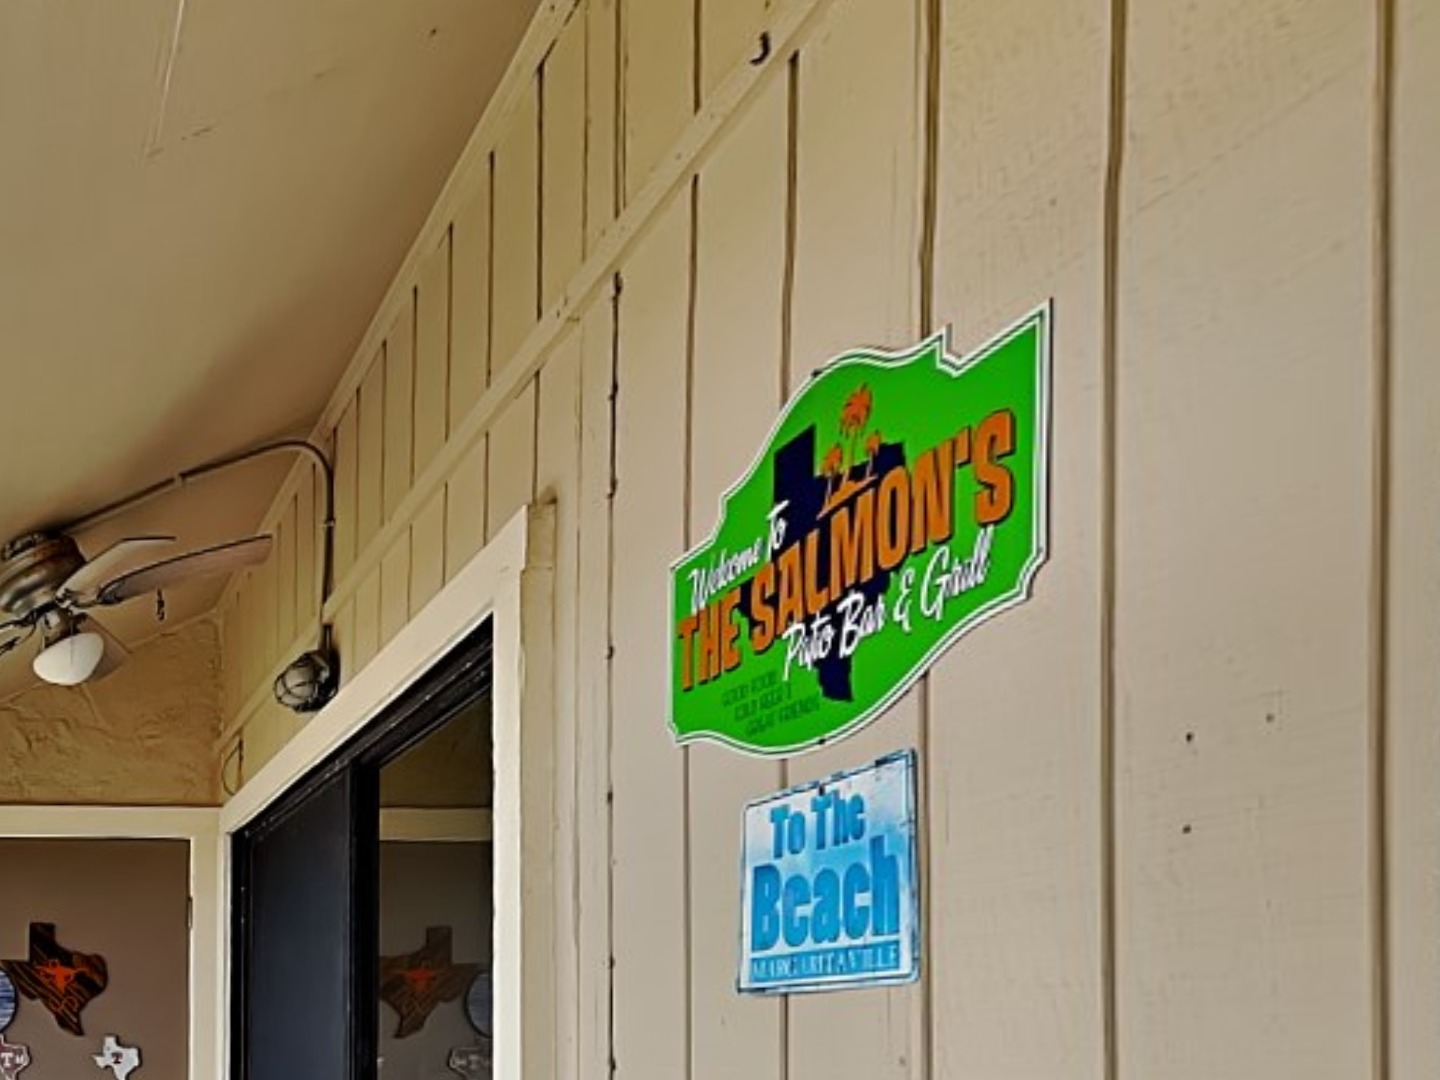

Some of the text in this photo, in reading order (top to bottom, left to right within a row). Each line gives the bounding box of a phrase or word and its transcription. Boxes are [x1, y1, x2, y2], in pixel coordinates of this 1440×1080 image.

[677, 408, 1015, 692] THE SALMON'S
[686, 499, 790, 616] Welcome To
[836, 588, 886, 659] Bar
[893, 566, 916, 632] &
[920, 524, 994, 622] Grill
[770, 788, 865, 859] To The
[751, 834, 900, 952] Beach
